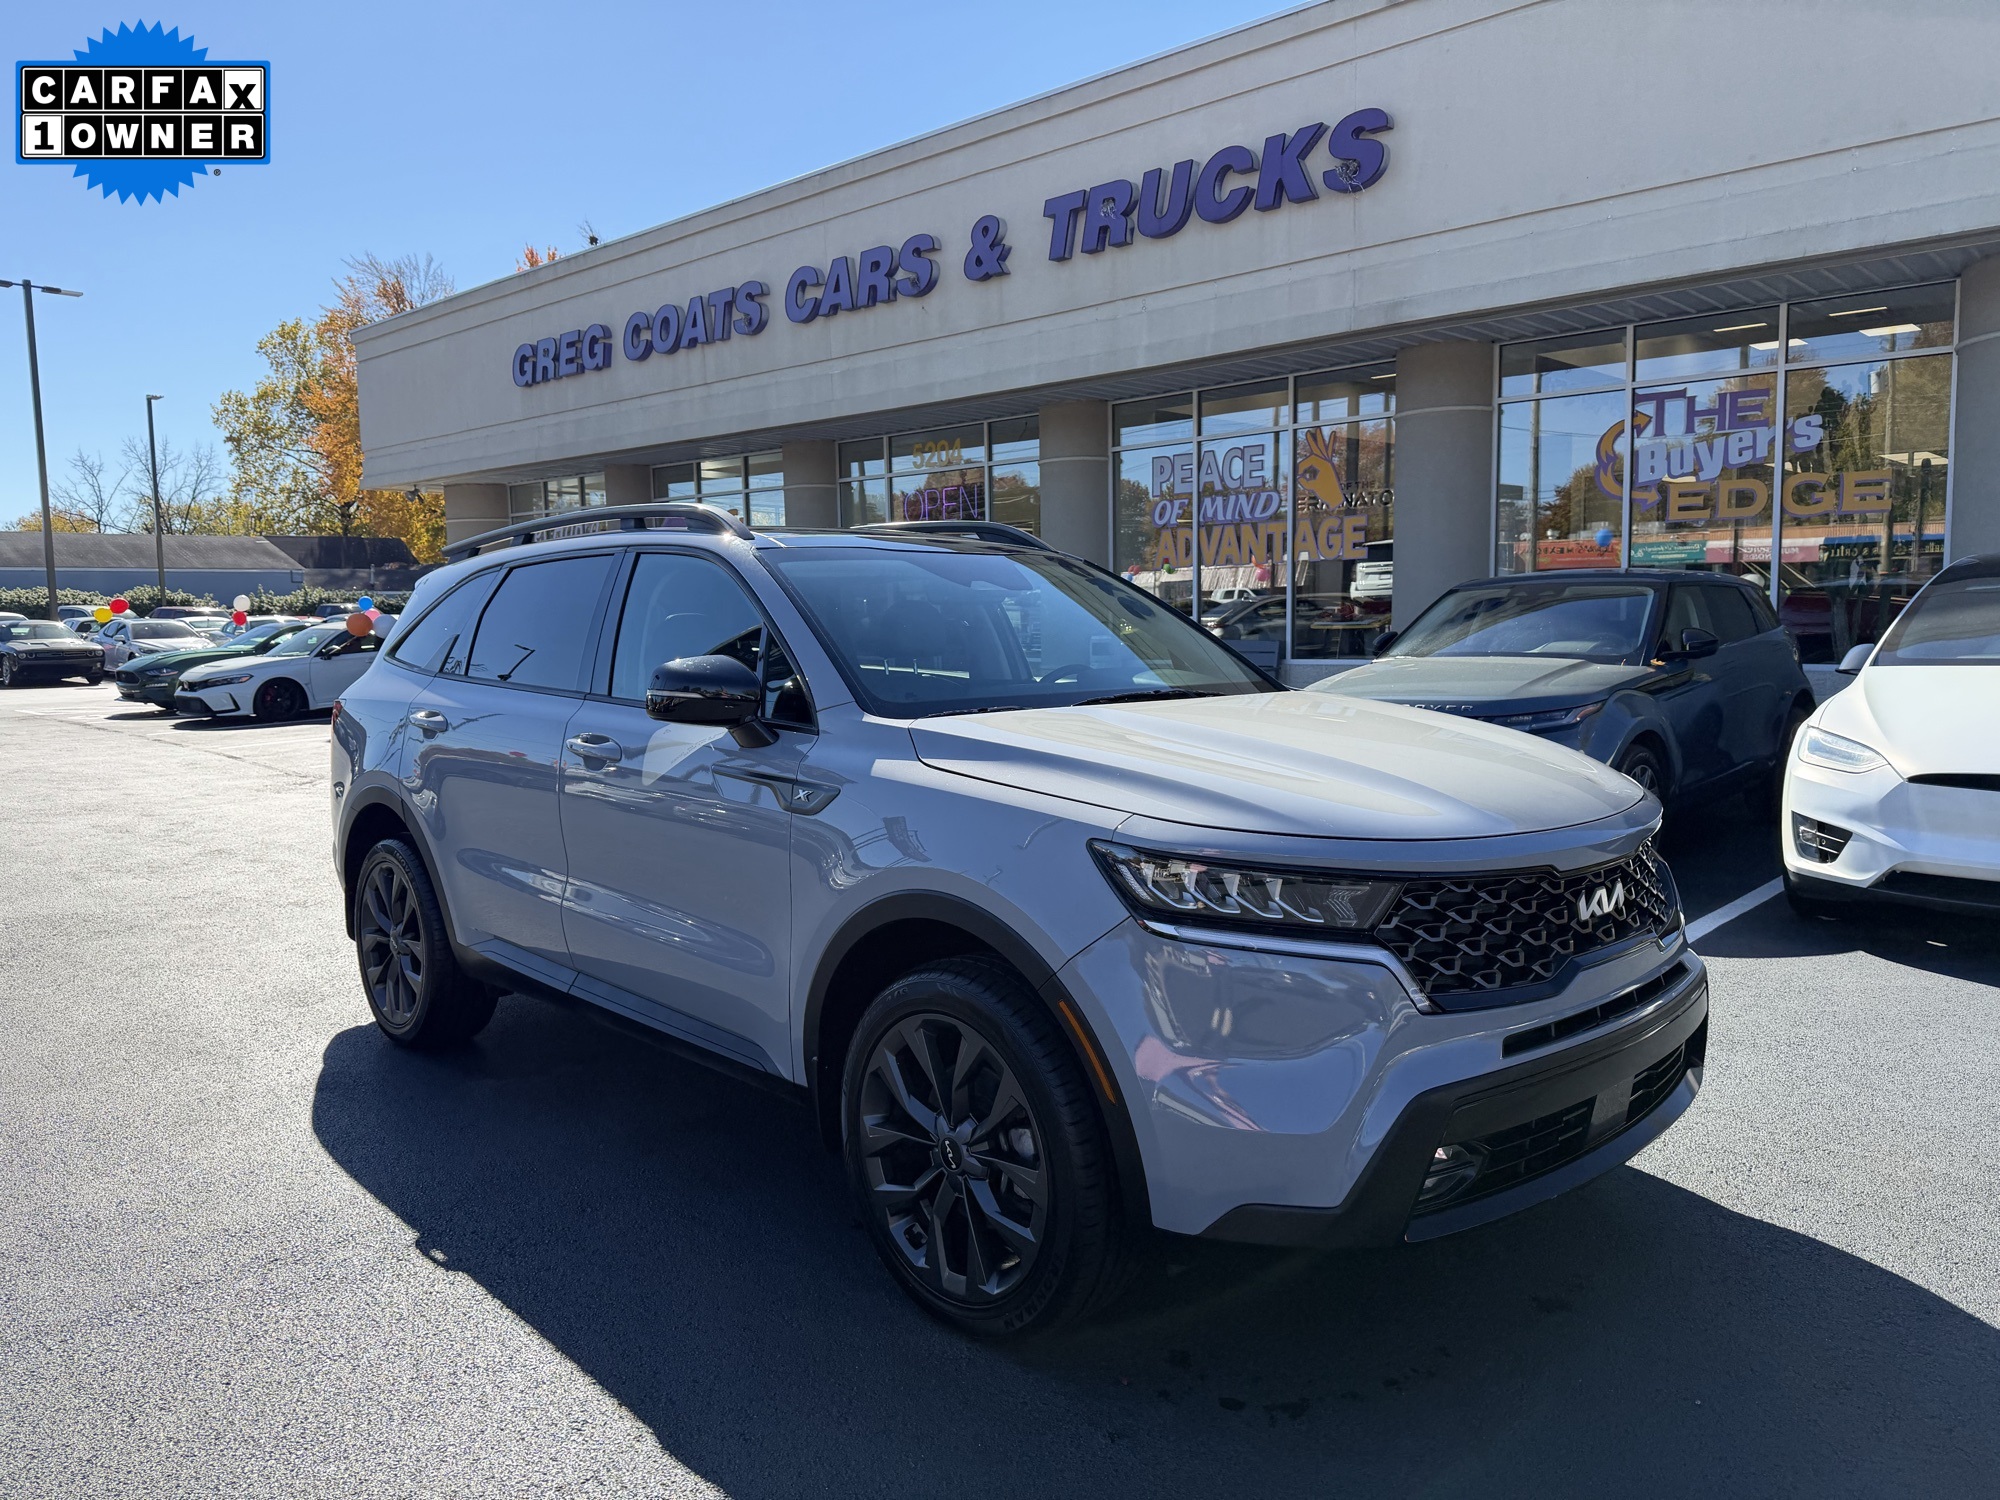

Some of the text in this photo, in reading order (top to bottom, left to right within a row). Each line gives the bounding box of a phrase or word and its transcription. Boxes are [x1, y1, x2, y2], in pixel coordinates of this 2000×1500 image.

[513, 107, 1394, 388] GREG COATS CARS & TRUCKS
[1634, 388, 1771, 437] THE
[912, 437, 963, 469] 5204
[1151, 443, 1265, 498] PEACE
[904, 484, 978, 521] OPEN
[1152, 489, 1282, 528] OF MIND
[1665, 468, 1893, 523] EDGE
[1153, 513, 1369, 571] ADVANTAGE
[1578, 878, 1625, 921] KIA
